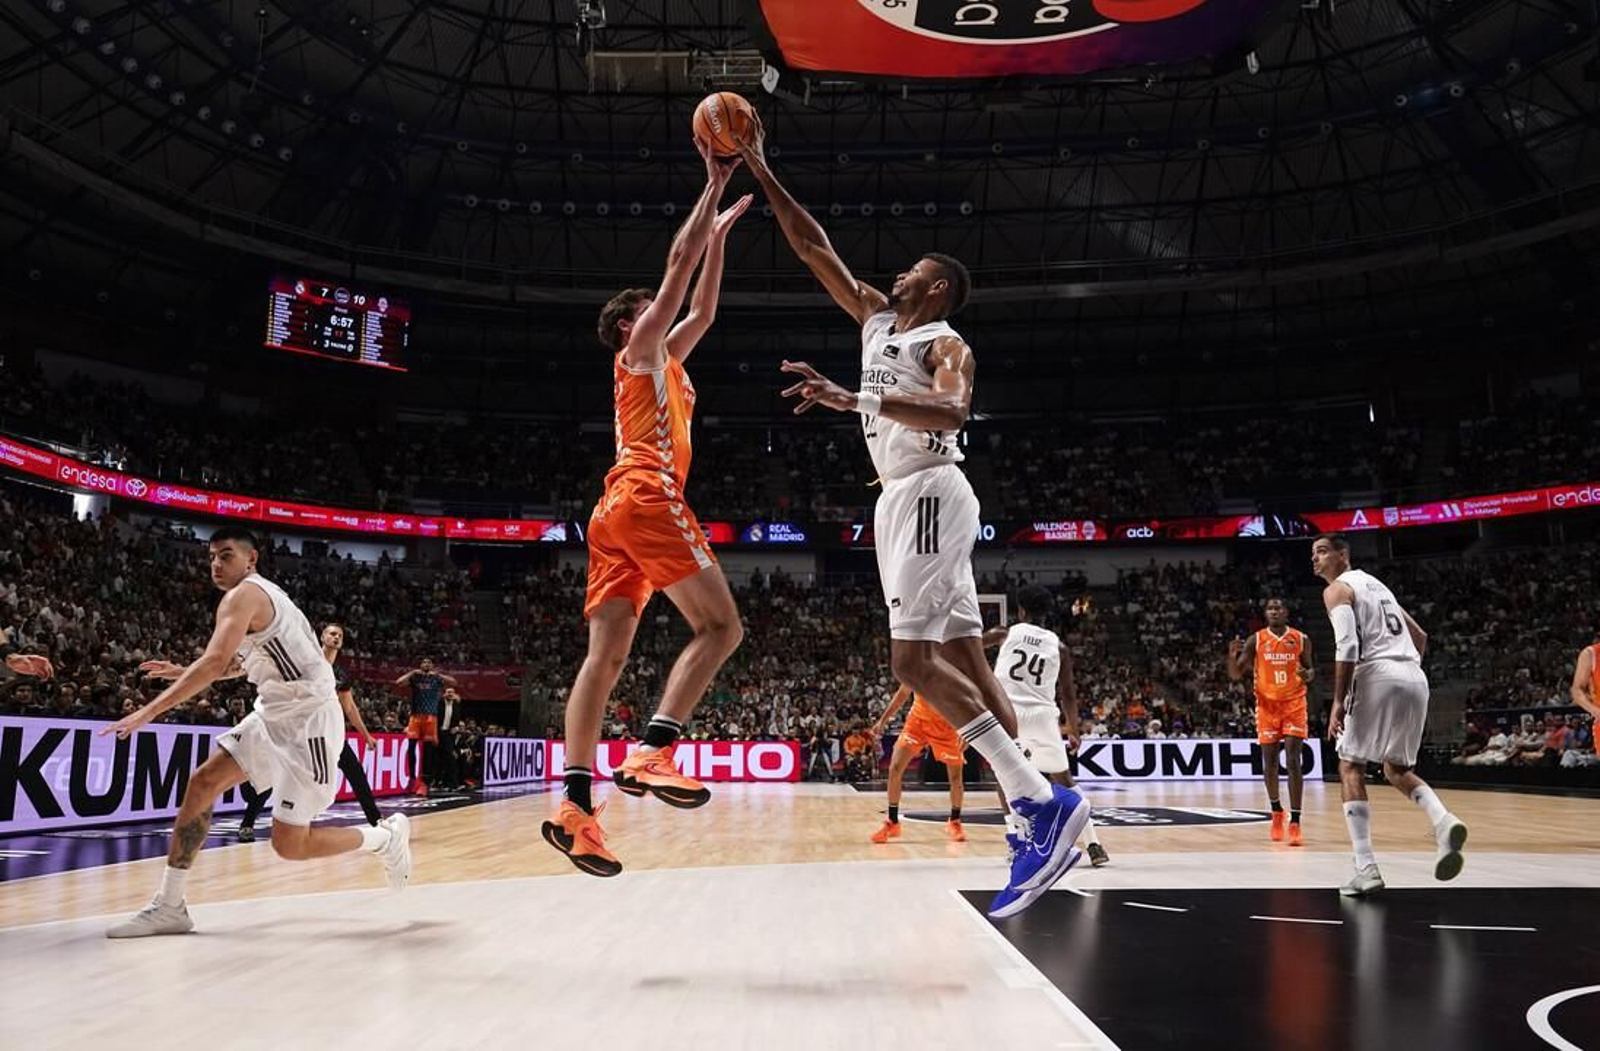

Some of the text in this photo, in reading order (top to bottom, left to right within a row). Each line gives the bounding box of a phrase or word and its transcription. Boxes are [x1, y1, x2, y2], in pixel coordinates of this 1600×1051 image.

[321, 287, 329, 297] 7
[353, 294, 366, 305] 10
[330, 314, 354, 328] 6:57
[861, 369, 899, 385] rates
[60, 465, 117, 491] endesa
[217, 499, 249, 513] pelayo
[769, 524, 791, 533] REAL
[851, 524, 863, 541] 7
[1033, 521, 1077, 532] VALENCIA
[1126, 526, 1154, 538] acb
[769, 533, 805, 541] MADRID
[1044, 531, 1077, 540] BASKET
[1009, 649, 1045, 686] 24
[1274, 670, 1287, 685] 10
[486, 741, 545, 780] KUMHO
[0, 726, 236, 821] KUM
